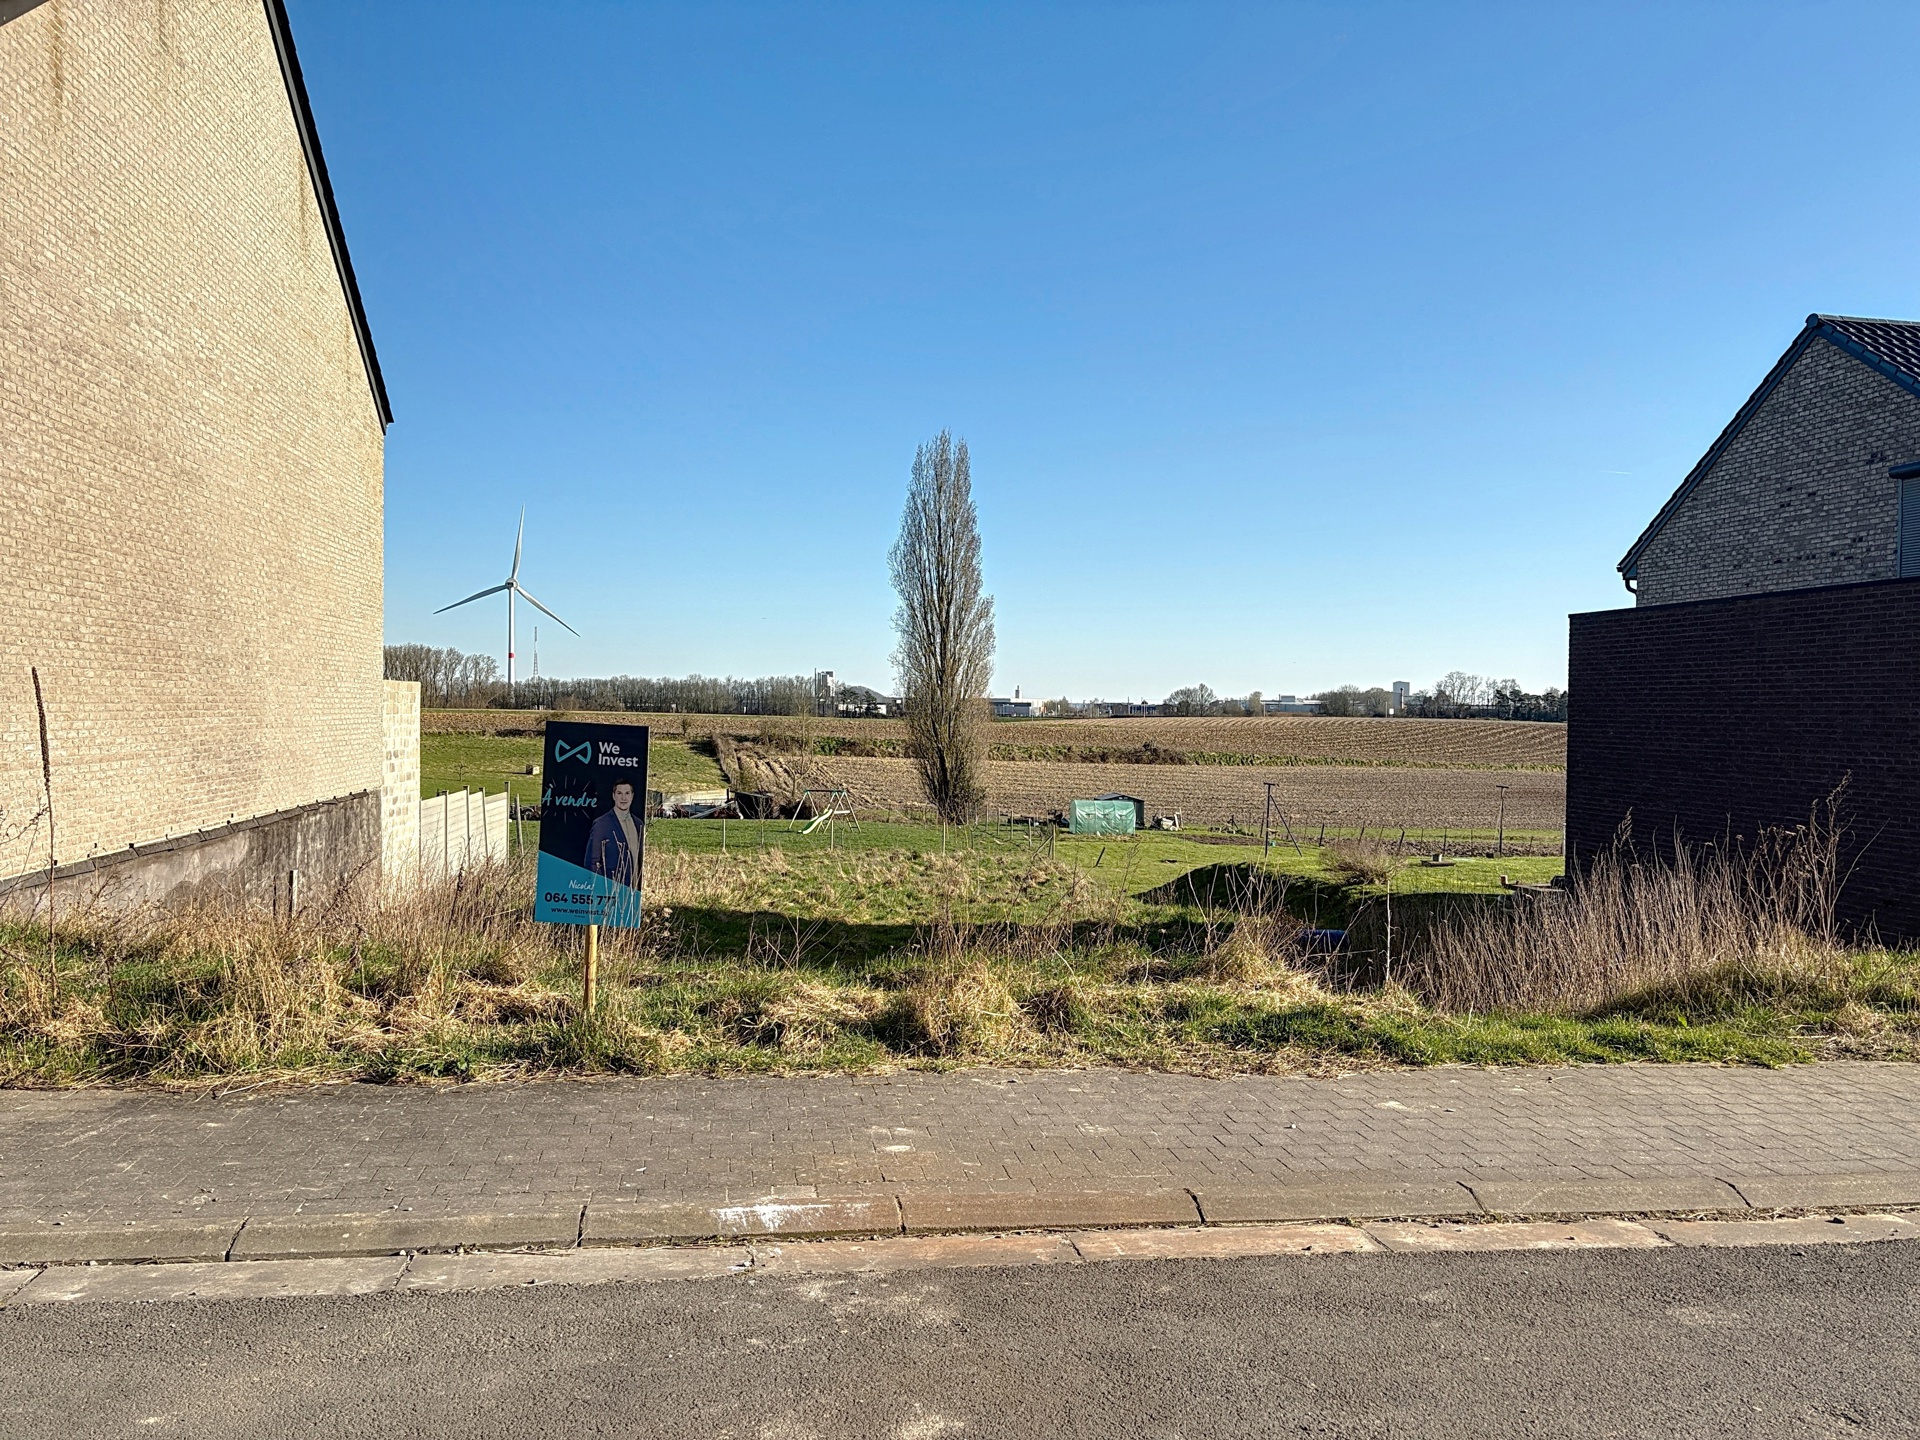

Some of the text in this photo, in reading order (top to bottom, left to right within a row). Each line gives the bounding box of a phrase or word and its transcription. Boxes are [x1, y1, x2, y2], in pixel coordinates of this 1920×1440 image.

[598, 741, 620, 754] We
[598, 753, 638, 767] Invest
[542, 783, 597, 807] À vendre
[544, 892, 568, 903] 064
[572, 894, 593, 904] 555
